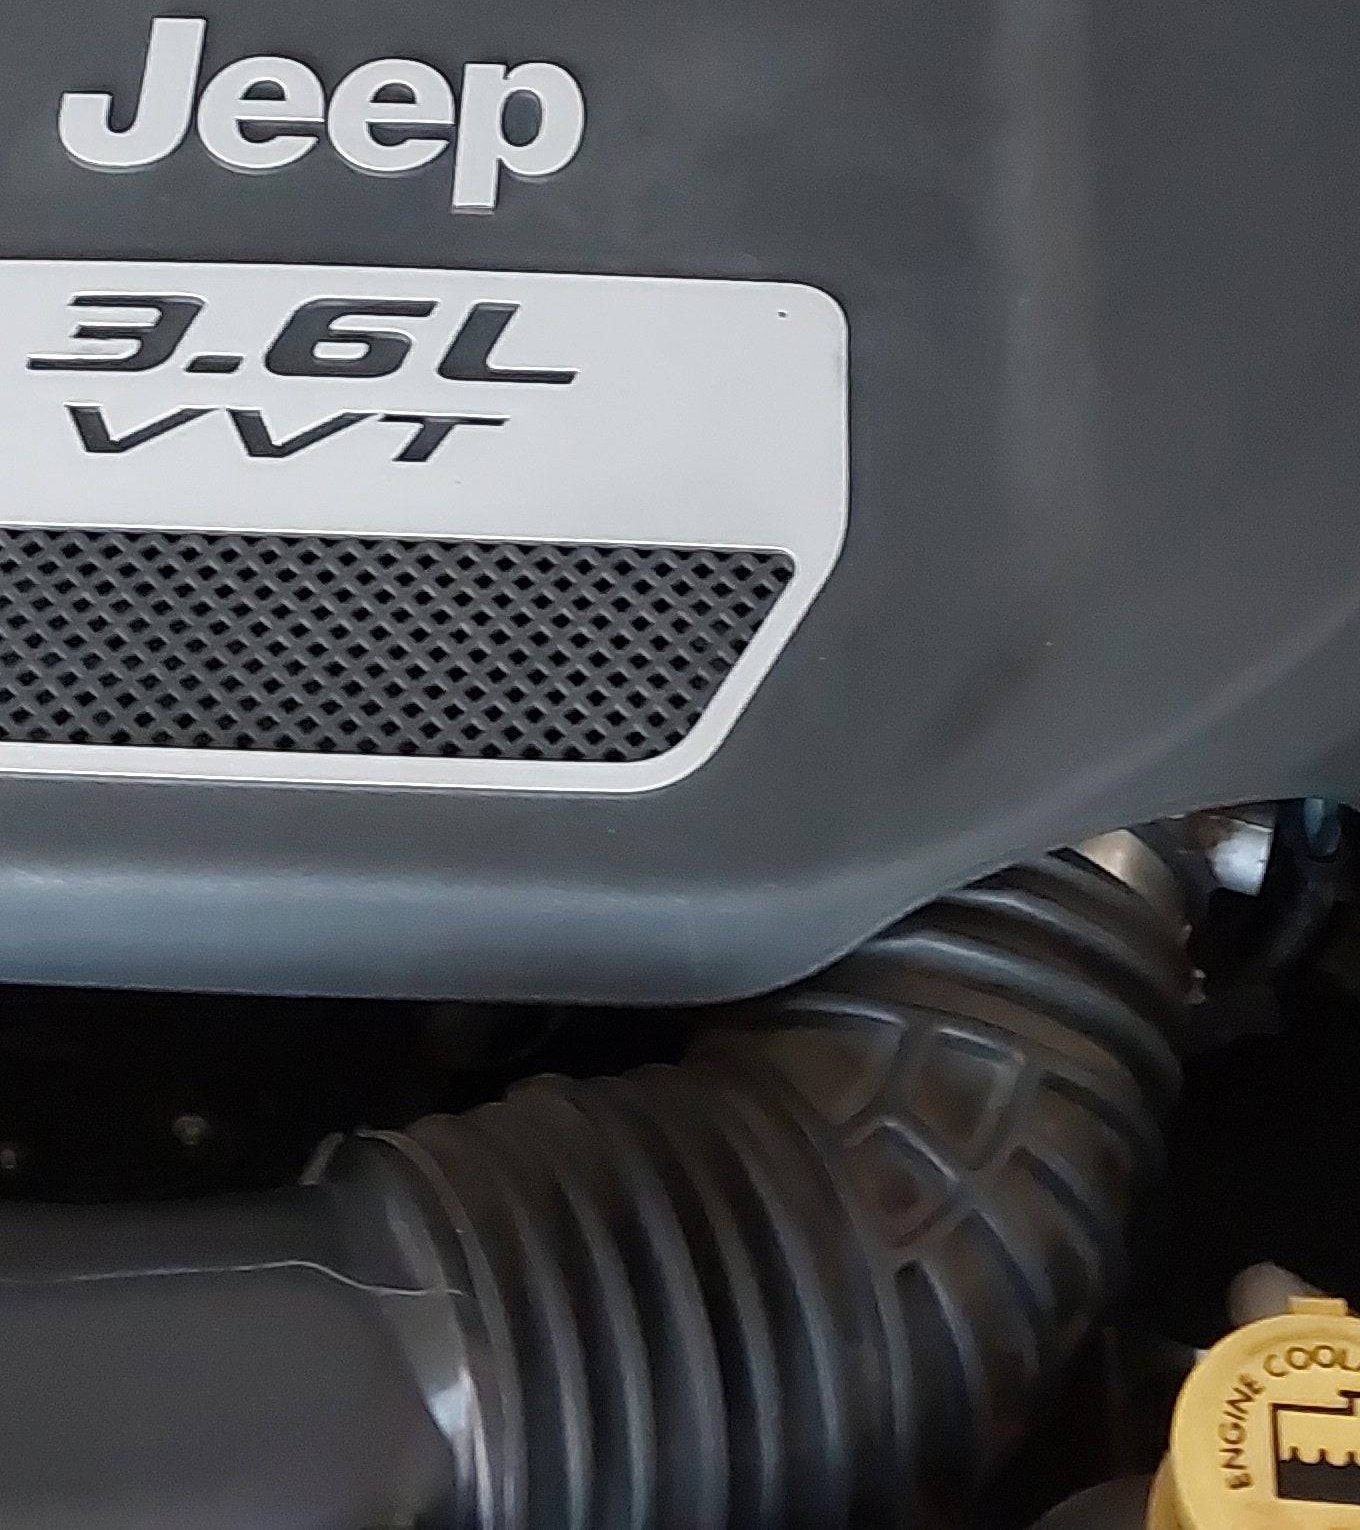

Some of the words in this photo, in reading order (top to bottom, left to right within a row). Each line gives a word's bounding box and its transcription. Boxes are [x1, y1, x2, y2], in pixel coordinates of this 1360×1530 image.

[58, 17, 586, 214] Jeep
[27, 291, 580, 384] 3.6L
[64, 402, 510, 462] VVT
[1218, 1374, 1266, 1490] ENGINE
